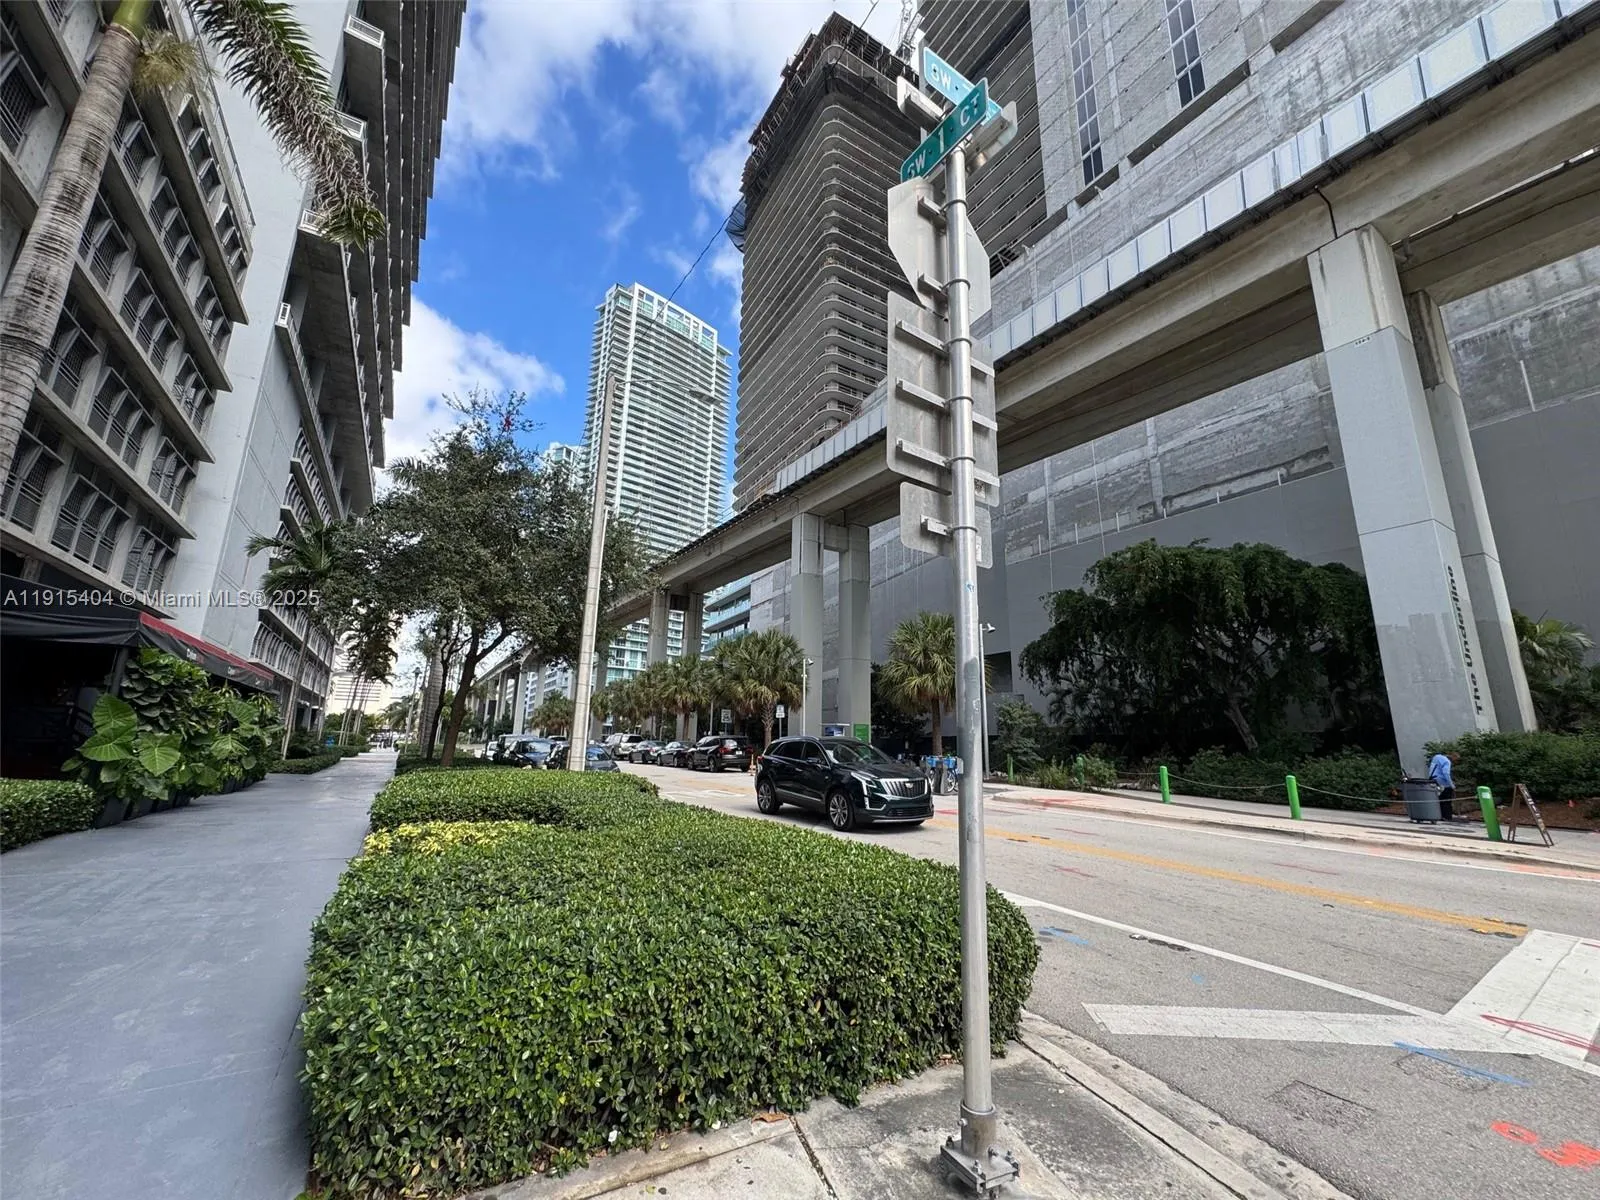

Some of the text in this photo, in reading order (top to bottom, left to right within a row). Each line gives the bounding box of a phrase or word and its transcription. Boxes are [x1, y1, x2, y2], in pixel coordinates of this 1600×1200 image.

[931, 63, 951, 91] SW
[907, 150, 926, 178] SW
[938, 126, 945, 153] 1
[1447, 565, 1483, 715] The Underline
